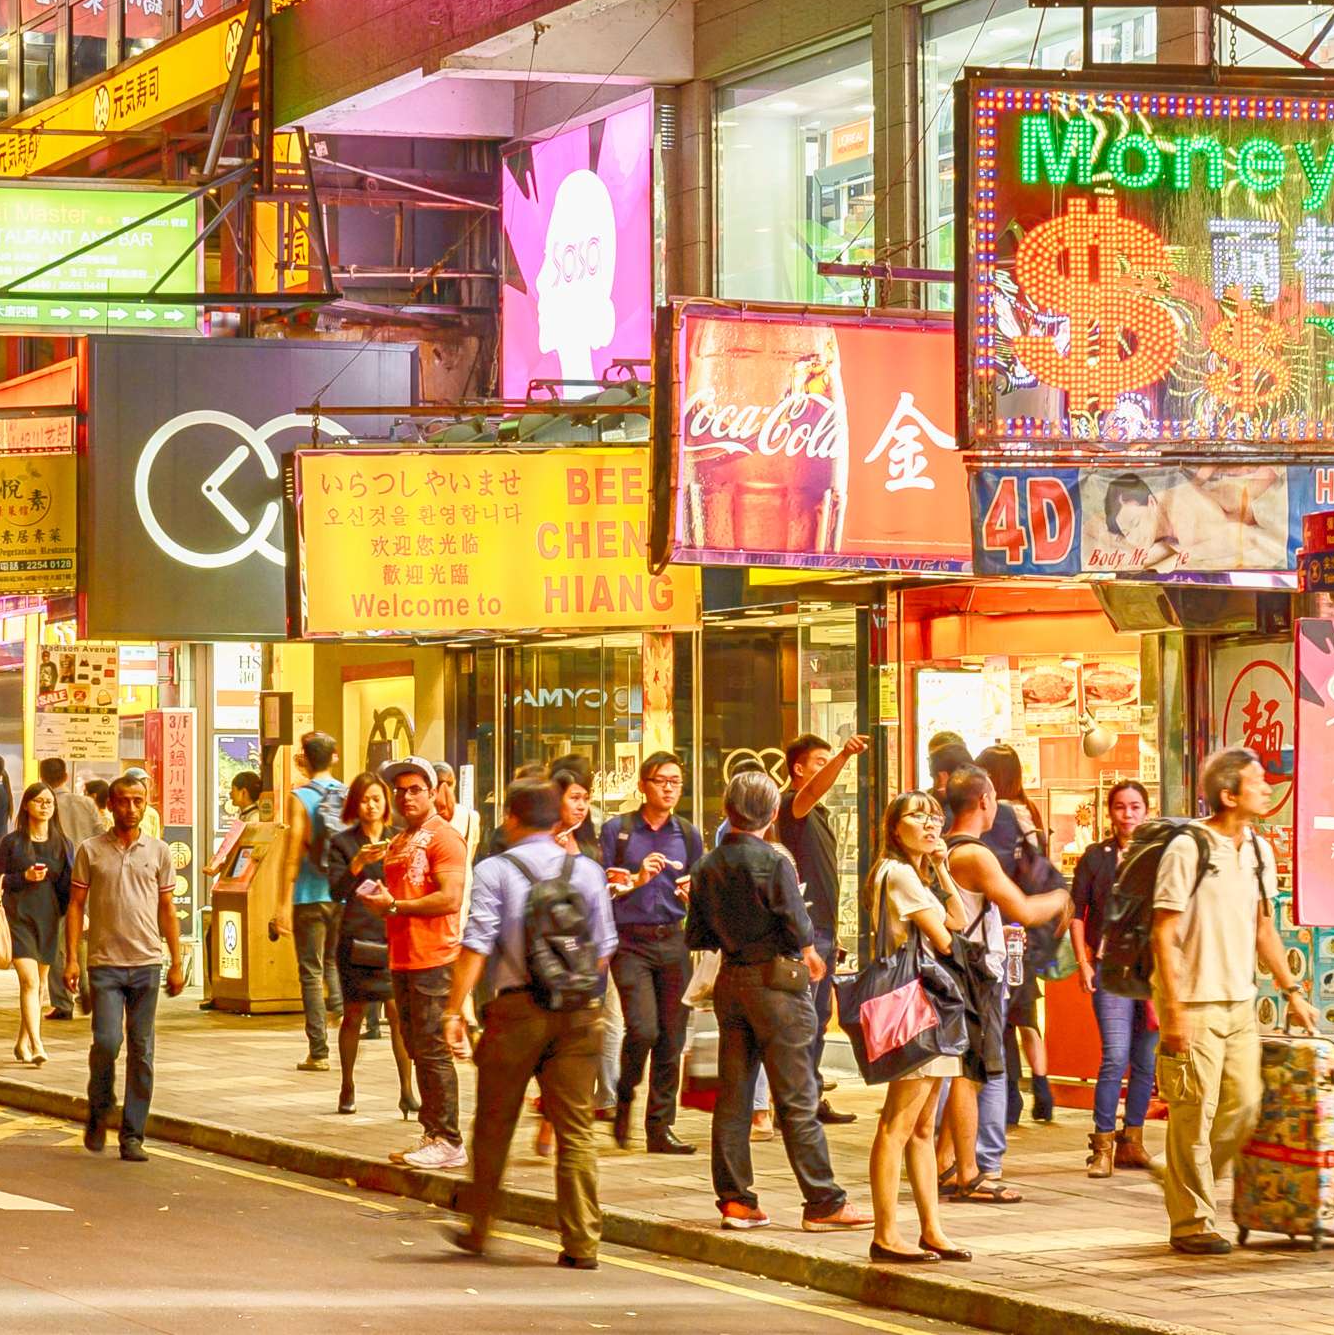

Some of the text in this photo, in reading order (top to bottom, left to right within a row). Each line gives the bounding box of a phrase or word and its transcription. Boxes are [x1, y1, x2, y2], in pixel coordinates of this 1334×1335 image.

[22, 201, 91, 226] Master
[863, 391, 960, 493] 金
[565, 467, 645, 506] BEE
[323, 502, 523, 527] 오신것을 환영합니다
[981, 474, 1077, 566] 4D
[370, 532, 480, 558] 欢迎您光临
[1088, 548, 1127, 569] Body
[381, 562, 470, 586] 歡迎光臨
[351, 592, 502, 618] Welcome to
[543, 573, 675, 614] HIANG
[82, 645, 117, 654] Avenue
[38, 689, 68, 707] SALE
[168, 714, 190, 730] 3/F
